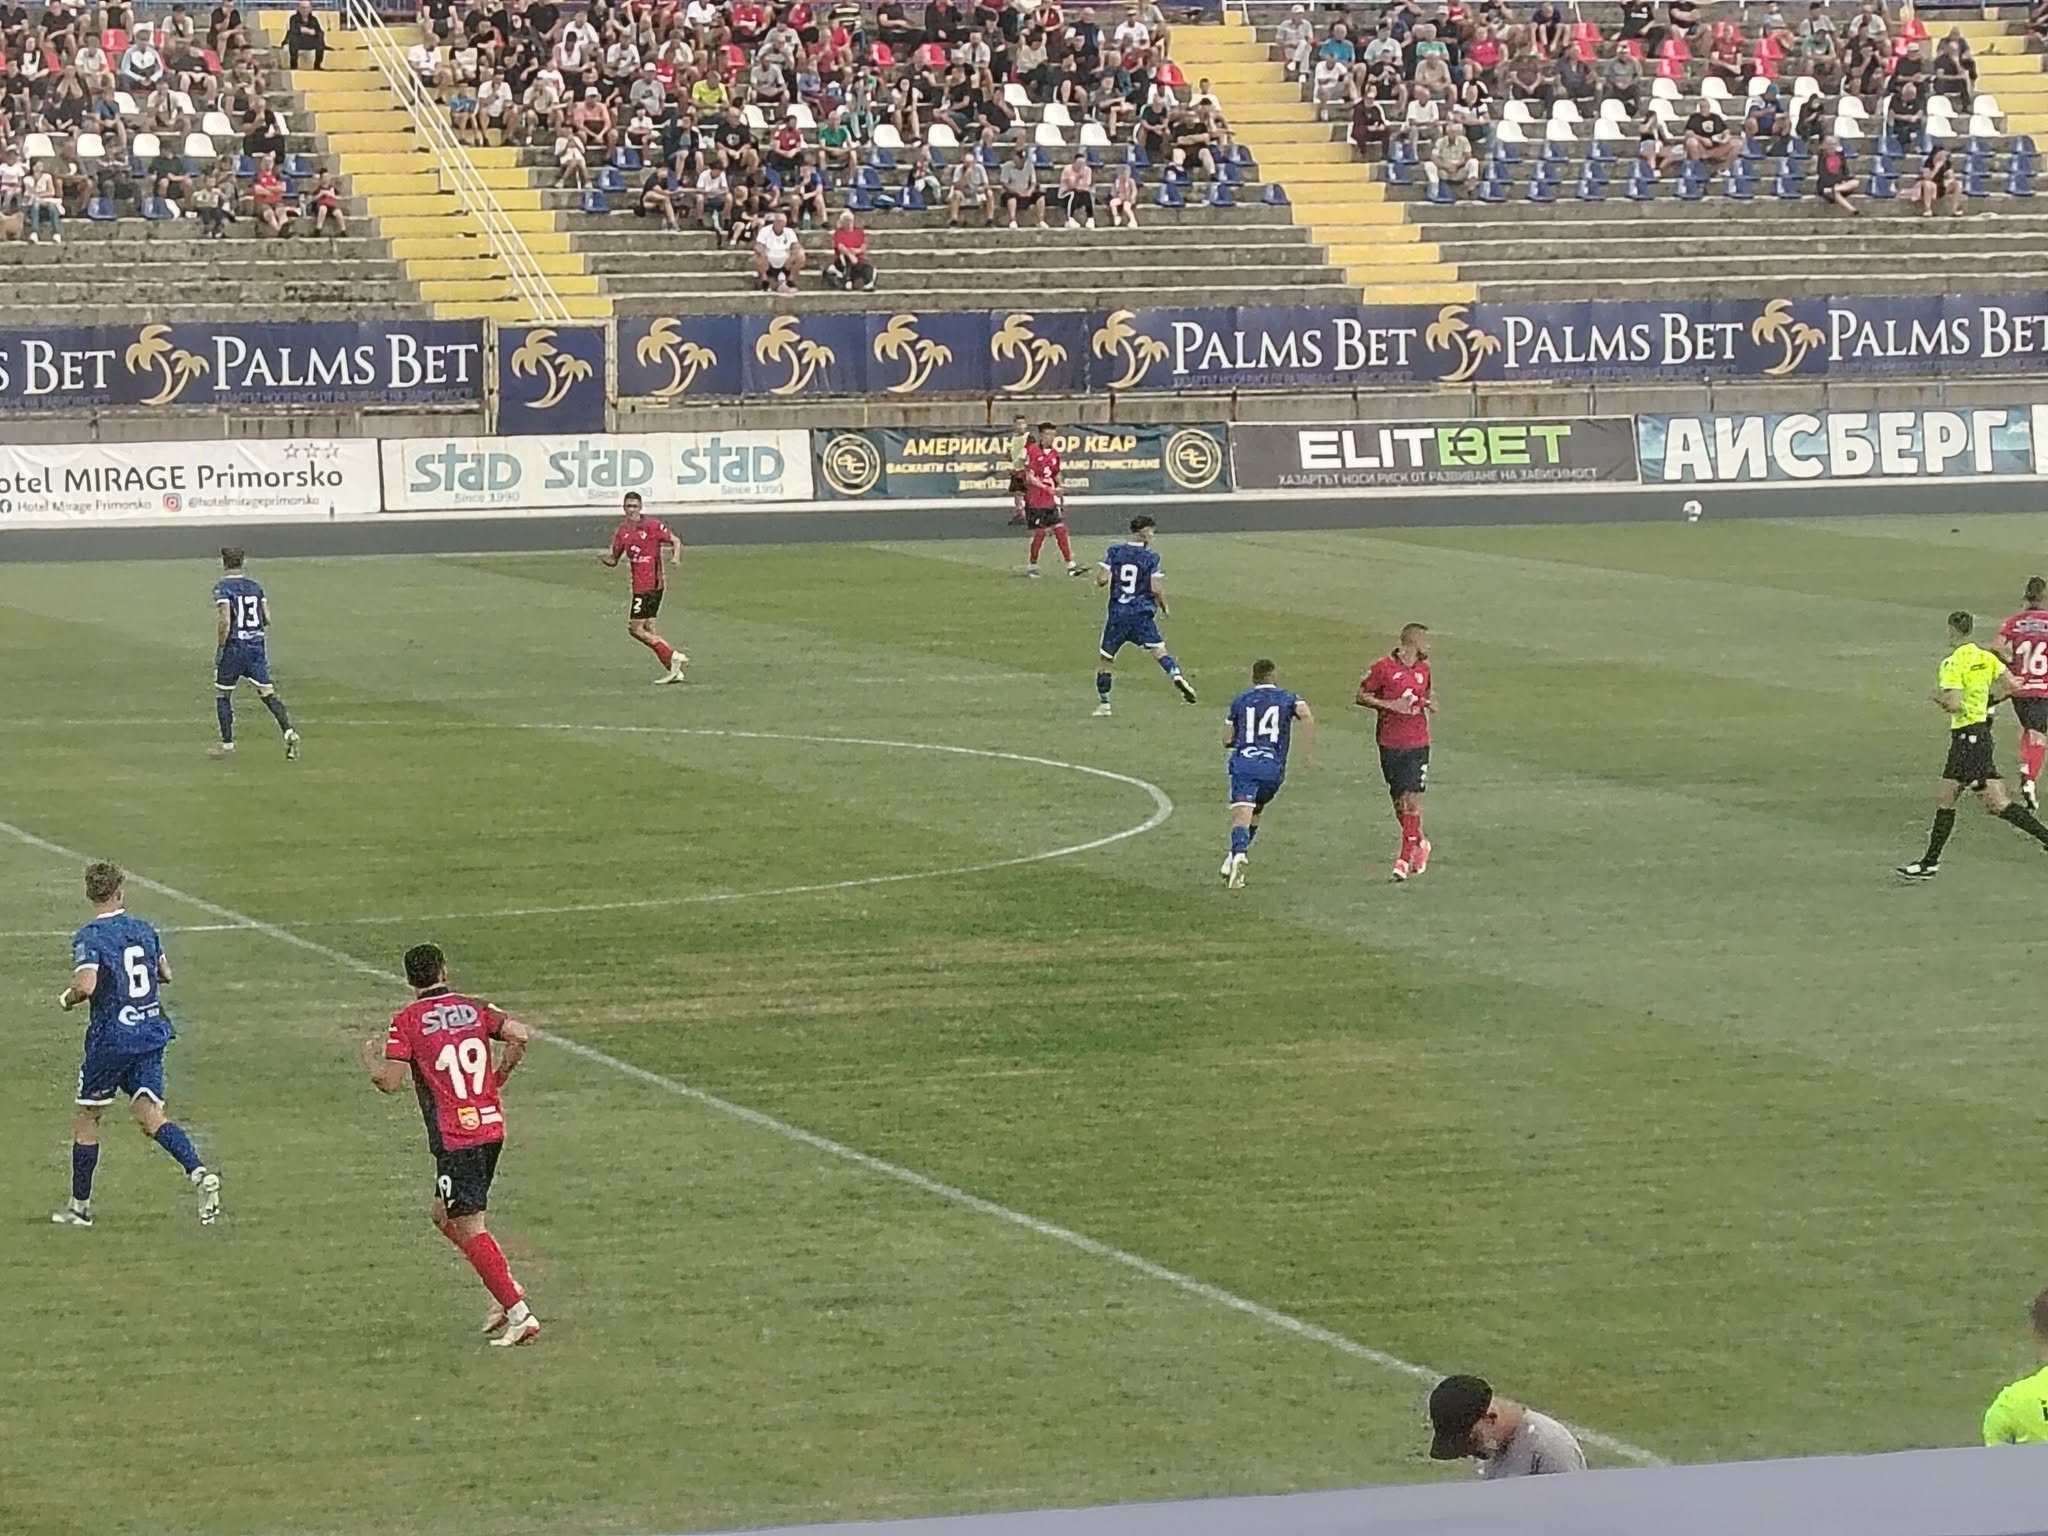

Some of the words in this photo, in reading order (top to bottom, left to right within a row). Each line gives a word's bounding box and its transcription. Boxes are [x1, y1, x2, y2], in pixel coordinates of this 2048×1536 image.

[1171, 321, 1323, 374] PALMS
[1332, 318, 1417, 371] BET
[1502, 316, 1651, 368] PALMS
[1660, 312, 1744, 365] BET
[1828, 309, 1971, 361] PALMS
[21, 340, 116, 395] BET
[212, 335, 376, 390] PALMS
[385, 333, 478, 388] BET
[1084, 435, 1137, 453] КЕАР
[1298, 425, 1572, 469] ELITBET
[65, 466, 186, 492] MIRAGE
[197, 460, 343, 489] Primorsko
[1278, 473, 1339, 485] ХАЗАРТЪТ
[1342, 472, 1376, 484] НОСИ
[1377, 472, 1408, 483] РИСК
[1411, 471, 1425, 482] ОТ
[1429, 470, 1498, 481] РАЗВИВАНЕ
[1500, 469, 1517, 479] НА
[1520, 467, 1598, 480] ЗАВИСИМОСТ
[17, 501, 49, 512] Hotel
[1120, 564, 1138, 594] 9
[237, 596, 260, 628] 13
[2015, 640, 2048, 676] 16
[1245, 706, 1280, 743] 14
[124, 945, 150, 999] 6
[435, 1037, 487, 1100] 19
